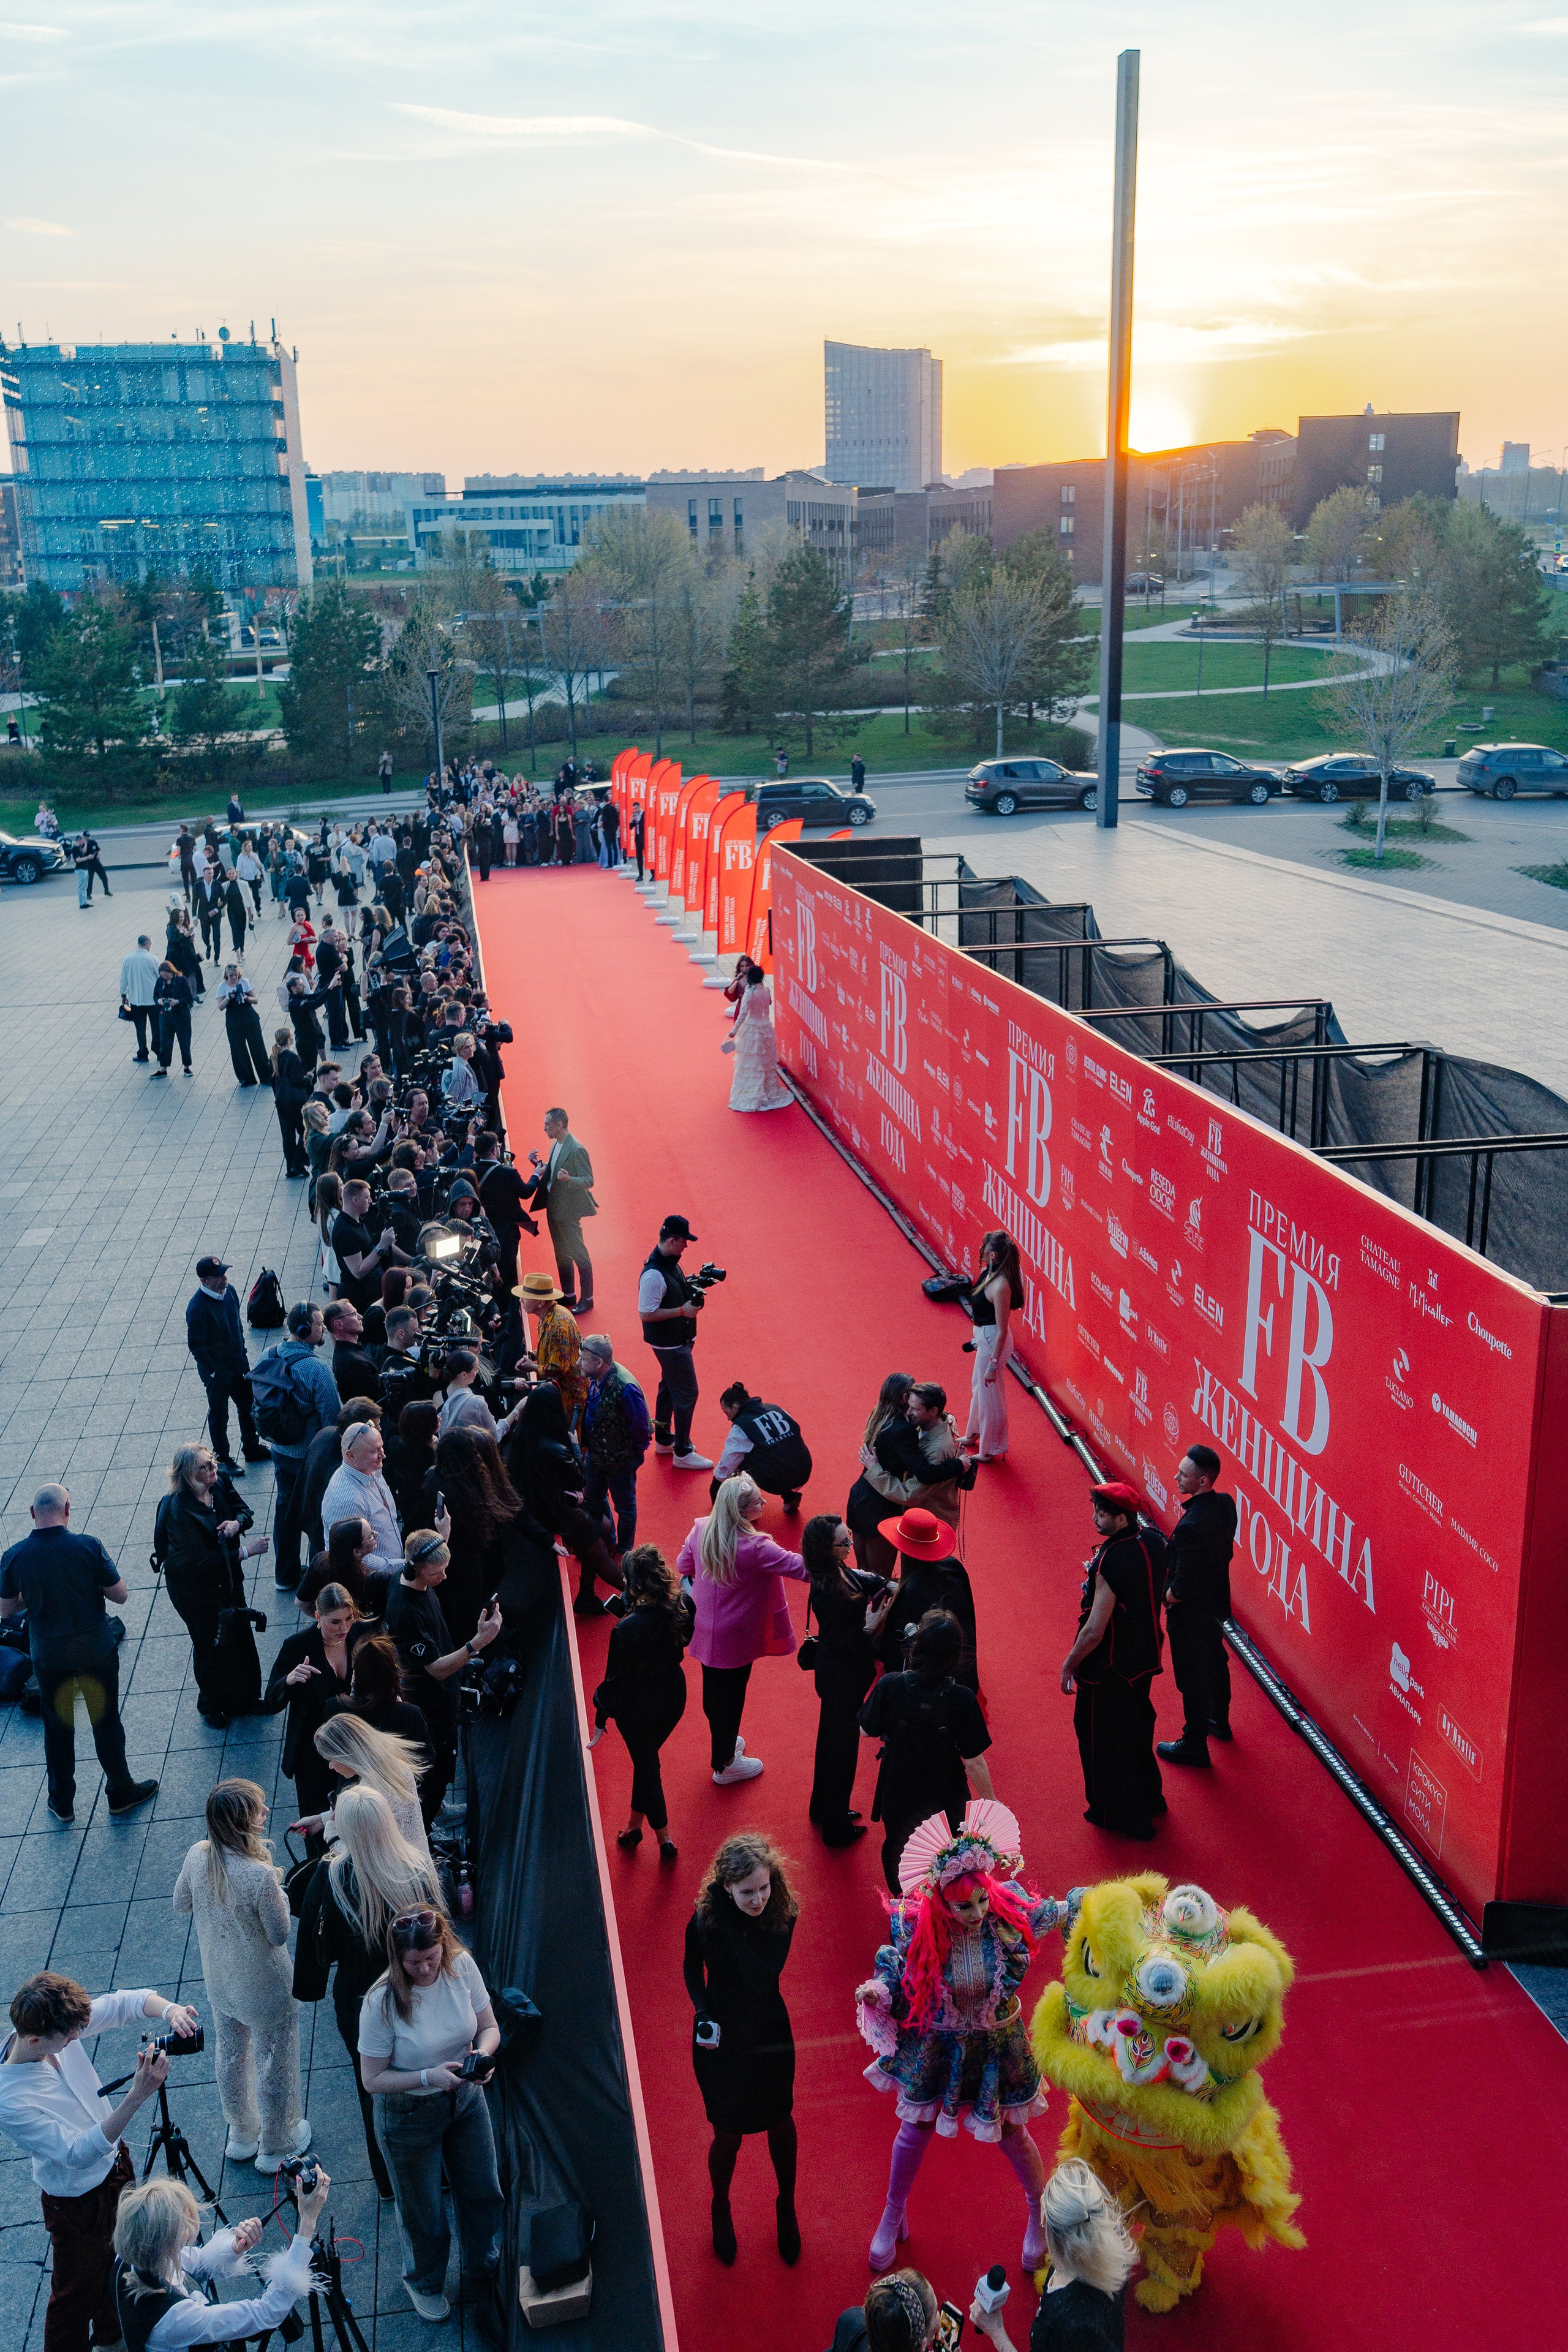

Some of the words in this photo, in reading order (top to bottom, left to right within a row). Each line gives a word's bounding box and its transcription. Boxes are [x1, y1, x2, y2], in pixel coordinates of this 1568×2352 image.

[725, 845, 753, 870] FB
[796, 899, 816, 993] FB
[880, 941, 907, 980] ПРЕМИЯ
[788, 976, 828, 1050] ЖЕНЩИНА
[879, 962, 907, 1076] FB
[799, 1030, 817, 1079] ГОДА
[1008, 1019, 1055, 1081] ПРЕМИЯ
[865, 1048, 922, 1144] ЖЕНЩИНА
[937, 1066, 949, 1090] ELEN
[1110, 1071, 1132, 1104] ELEN
[881, 1112, 907, 1174] ГОДА
[1005, 1047, 1052, 1208] FB
[1071, 1117, 1091, 1140] CHATEAU
[1071, 1128, 1091, 1153] TAMAGNE
[1136, 1112, 1150, 1128] Apple
[1150, 1121, 1160, 1136] God
[1167, 1115, 1194, 1147] ElishaCoy
[1208, 1123, 1222, 1156] FB
[1200, 1145, 1227, 1175] ЖЕНЩИНА
[1207, 1164, 1219, 1183] ГОДА
[1061, 1164, 1075, 1196] PIPL
[1151, 1167, 1175, 1200] RESEDA
[982, 1157, 1076, 1311] ЖЕНЩИНА
[1108, 1218, 1128, 1251] BLUEFIN
[1250, 1188, 1341, 1291] ПРЕМИЯ
[1361, 1234, 1401, 1273] CHATEAU
[1360, 1249, 1400, 1290] TAMAGNE
[1021, 1274, 1046, 1343] ДА
[1166, 1283, 1184, 1305] LUCIANO
[1194, 1283, 1224, 1327] ELEN
[1078, 1324, 1099, 1354] GUTICHER
[1238, 1224, 1333, 1456] FB
[1468, 1311, 1512, 1360] Choupette
[1136, 1371, 1147, 1403] FB
[1385, 1376, 1414, 1408] LUCIANO
[752, 1411, 791, 1442] FB
[1089, 1409, 1110, 1445] RUBEUS
[1135, 1407, 1145, 1426] ГОДА
[1442, 1403, 1477, 1444] YAMAGUCHI
[1115, 1435, 1136, 1466] DREAME
[1144, 1464, 1167, 1504] BLUEFIN
[1191, 1357, 1377, 1615] ЖЕНЩИНА
[1399, 1463, 1443, 1517] GUTICHER
[1234, 1484, 1311, 1635] ГОДА
[1451, 1517, 1478, 1551] MADAME
[1479, 1547, 1498, 1572] COCO
[1423, 1570, 1458, 1632] PIPL
[1422, 1602, 1440, 1624] KARAOKE
[1446, 1629, 1457, 1644] CLUB
[1394, 1655, 1409, 1680] hello
[1410, 1676, 1425, 1700] park
[1389, 1683, 1422, 1726] АВИАПАРК
[1383, 1753, 1398, 1773] STUDIO
[1411, 1781, 1431, 1812] СИТИ
[1412, 1761, 1442, 1805] КРОКУС
[1409, 1798, 1430, 1833] МОЛЛ
